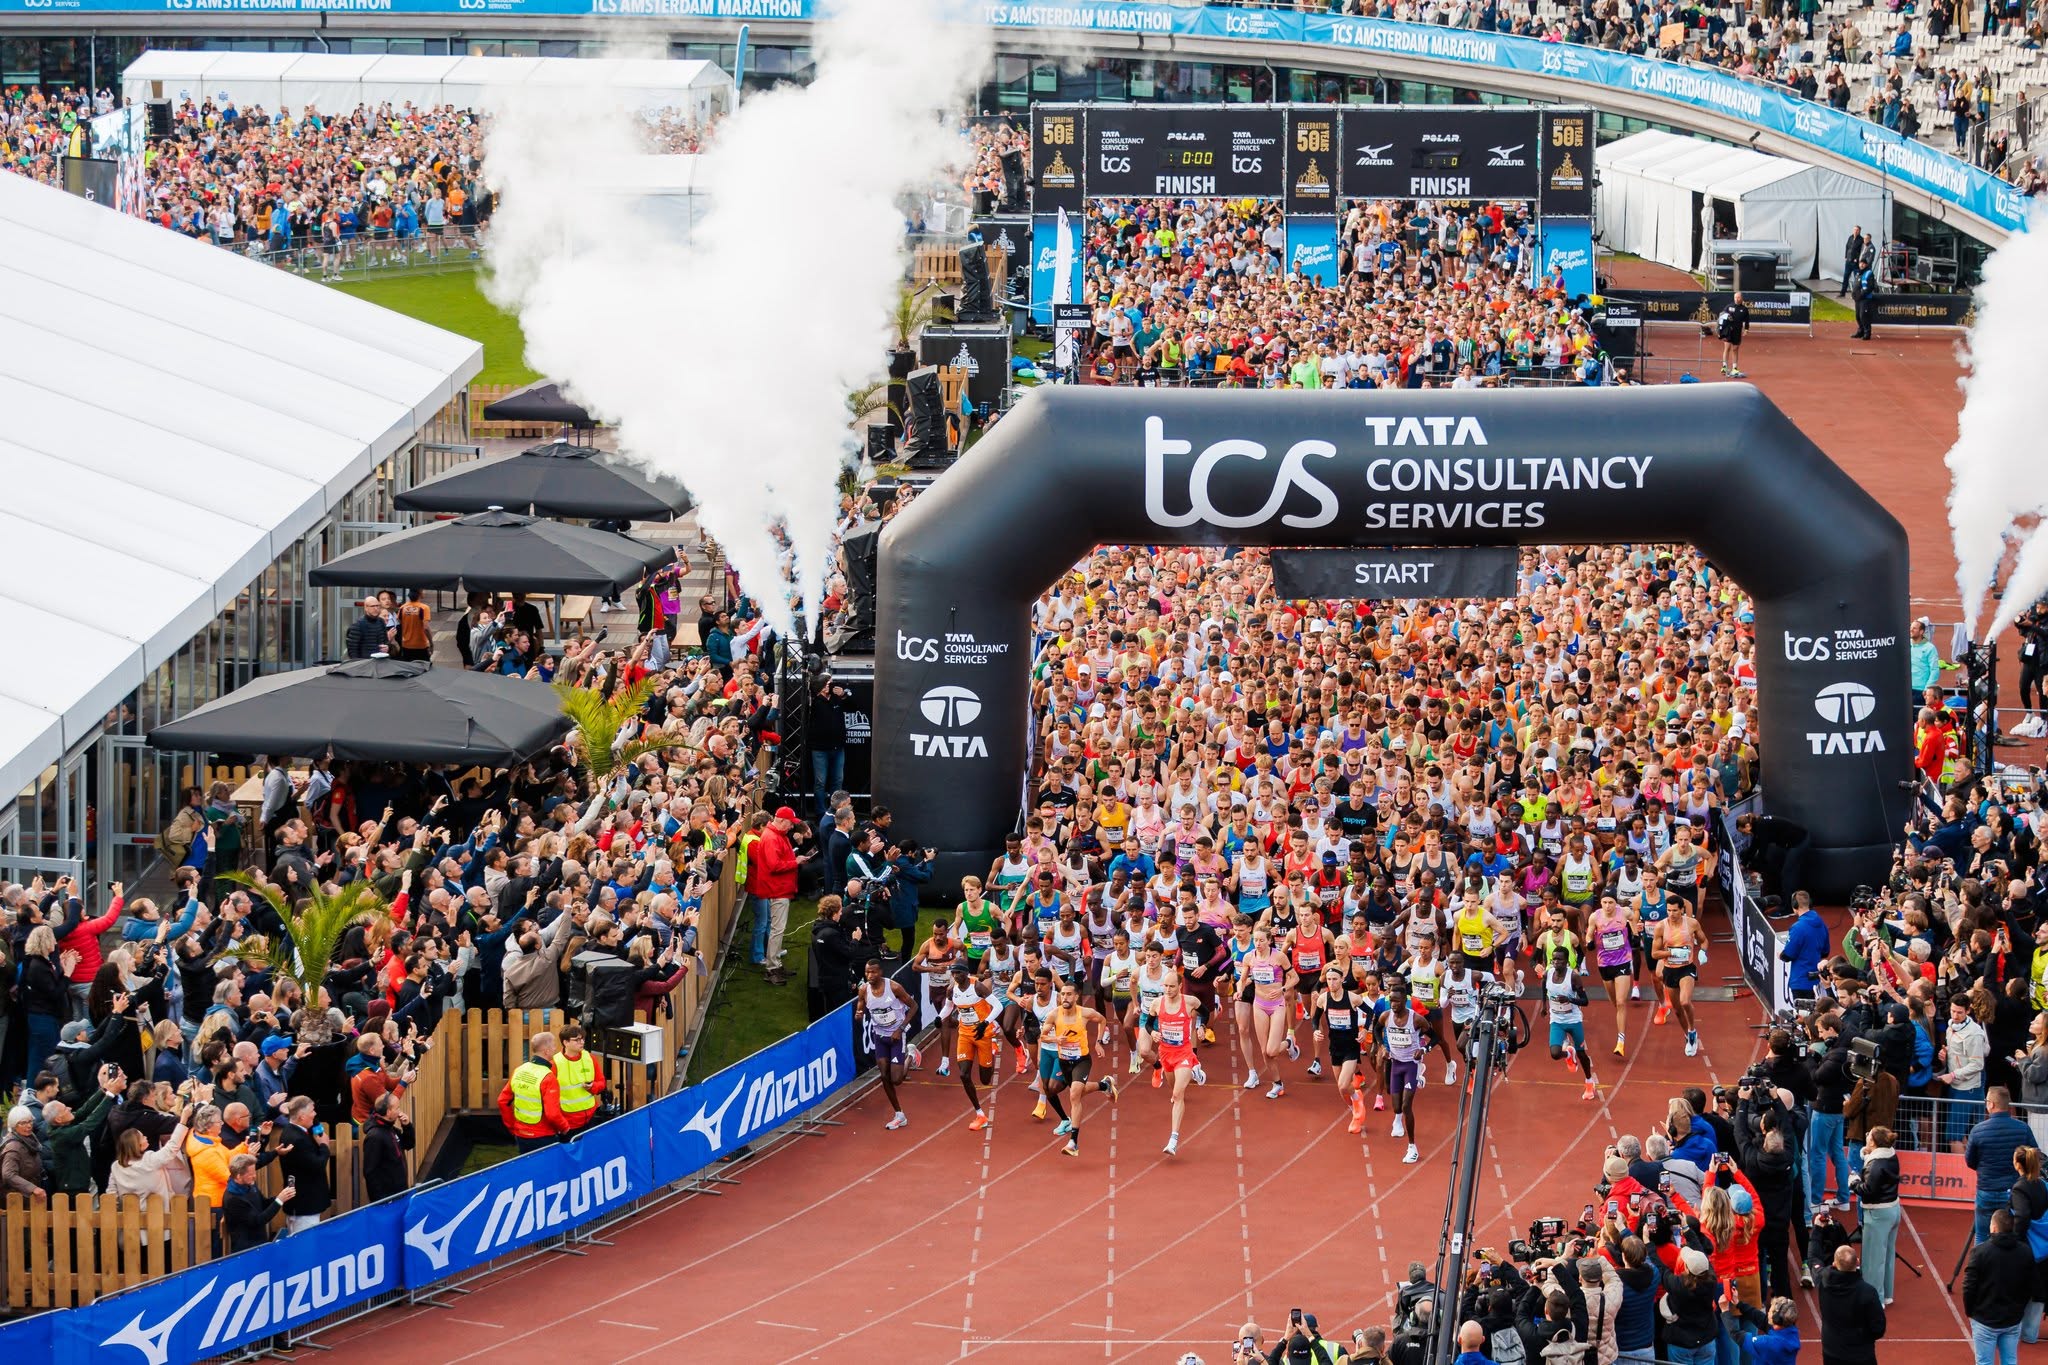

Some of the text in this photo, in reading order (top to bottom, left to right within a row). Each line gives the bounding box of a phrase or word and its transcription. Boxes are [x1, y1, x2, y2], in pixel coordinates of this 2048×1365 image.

[620, 0, 713, 15] AMSTERDAM
[717, 0, 802, 17] MARATHON
[984, 6, 1172, 31] TCS AMSTERDAM MARATHON
[1226, 13, 1248, 33] tcs
[1331, 24, 1497, 63] TCS AMSTERDAM MARATHON
[1543, 48, 1562, 70] tcs
[1631, 66, 1762, 117] TCS AMSTERDAM MARATHON
[1043, 123, 1065, 145] 50
[1167, 132, 1205, 141] POLAR
[1297, 129, 1320, 152] 50
[1422, 134, 1460, 143] POLAR
[1552, 125, 1575, 147] 50
[1100, 153, 1131, 174] tcs
[1232, 154, 1263, 174] tcs
[1155, 175, 1216, 194] FINISH
[1410, 177, 1471, 195] FINISH
[1924, 159, 1969, 198] MARATHON
[1294, 243, 1313, 258] Run
[1550, 248, 1568, 262] Run
[1647, 301, 1659, 313] 50
[1660, 302, 1680, 312] YEARS
[1776, 309, 1792, 317] 2025
[1915, 305, 1927, 317] 50
[1928, 307, 1947, 316] YEARS
[1365, 416, 1488, 446] TATA
[1145, 415, 1339, 528] tcs
[1365, 455, 1653, 492] CONSULTANCY
[1365, 502, 1545, 529] SERVICES
[1355, 563, 1434, 585] START
[945, 633, 975, 643] TATA
[1834, 629, 1864, 639] TATA
[1835, 636, 1896, 650] CONSULTANCY
[897, 629, 939, 663] tcs
[944, 643, 1009, 654] CONSULTANCY
[1784, 630, 1830, 661] tcs
[1835, 649, 1878, 661] SERVICES
[944, 655, 988, 664] SERVICES
[909, 733, 989, 758] TATA
[1806, 730, 1886, 755] TATA
